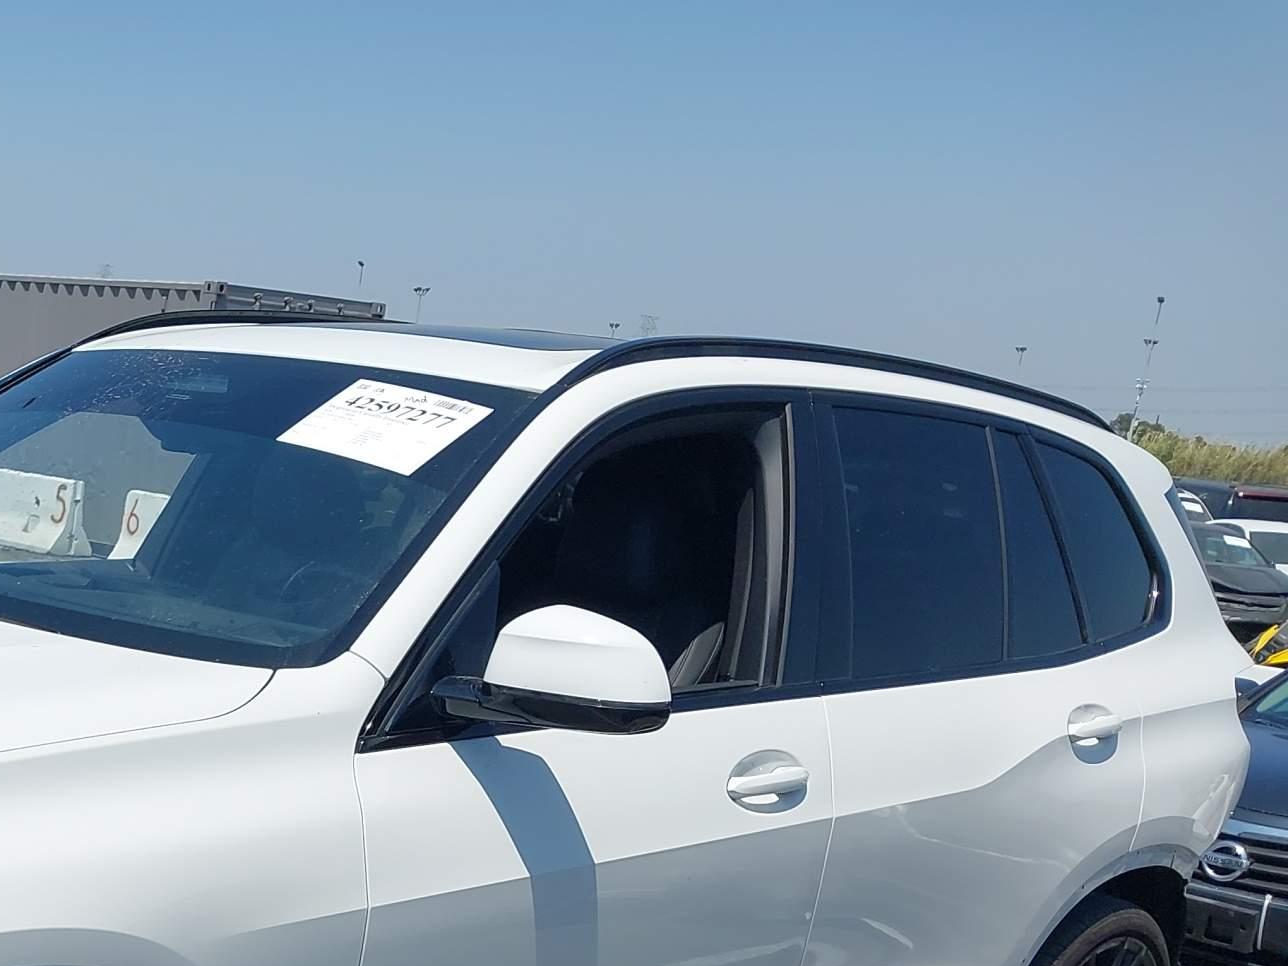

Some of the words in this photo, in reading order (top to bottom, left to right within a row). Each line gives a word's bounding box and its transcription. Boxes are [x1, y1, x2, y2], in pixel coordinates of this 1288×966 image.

[345, 395, 457, 428] 42597277
[51, 484, 67, 523] 5
[127, 498, 139, 535] 6
[1202, 854, 1243, 868] NISSAN
